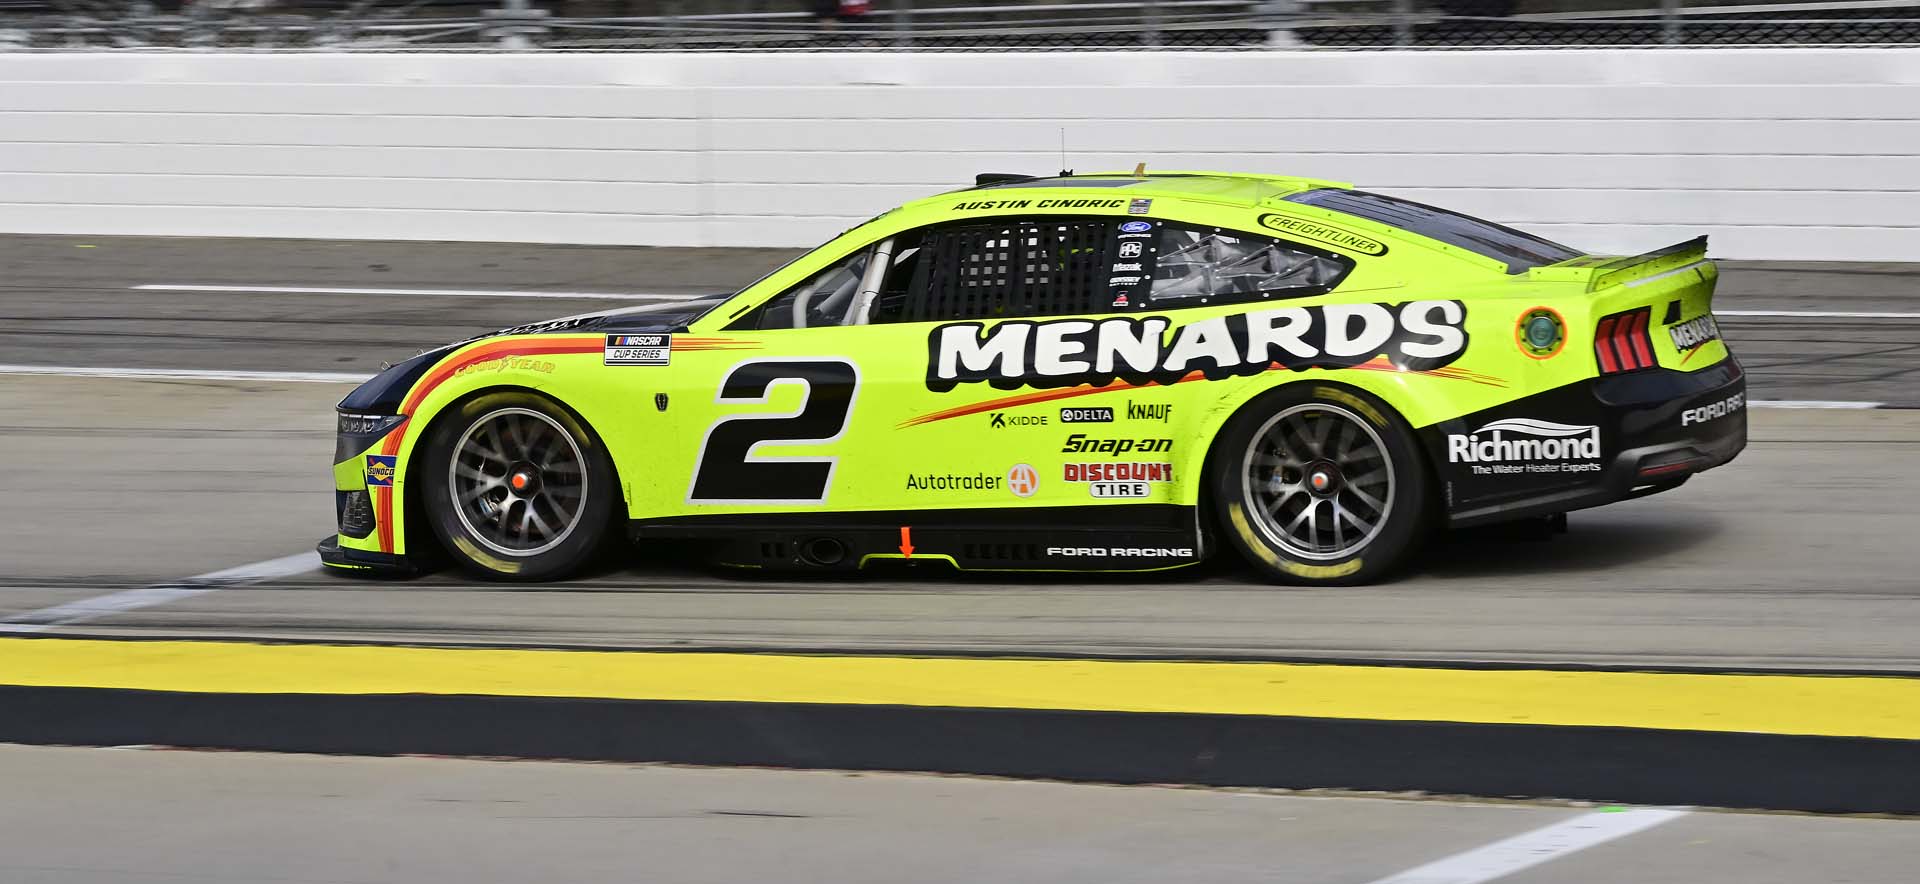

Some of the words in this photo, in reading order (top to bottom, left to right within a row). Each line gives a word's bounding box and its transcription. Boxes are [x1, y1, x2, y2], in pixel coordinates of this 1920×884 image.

[952, 200, 1032, 210] AUSTIN
[1036, 199, 1125, 208] CINDRIC
[1268, 217, 1377, 252] FREIGHTLINER
[626, 336, 662, 346] NASCAR
[932, 299, 1467, 384] MENARDS
[613, 350, 630, 359] CUP
[631, 349, 661, 359] SERIES
[454, 356, 557, 377] GOODYEAR
[1074, 409, 1112, 421] DELTA
[1127, 400, 1172, 423] KNAUF
[1681, 400, 1726, 427] FORD
[1008, 416, 1048, 426] KIDDE
[686, 358, 861, 504] 2
[1062, 434, 1173, 457] Snap-on
[1448, 427, 1600, 462] Richmond
[367, 466, 395, 476] SUNOCO
[1064, 463, 1172, 481] DISCOUNT
[1472, 465, 1492, 475] The
[1492, 464, 1524, 473] Water
[1526, 463, 1559, 473] Heater
[1561, 462, 1601, 473] Experts
[906, 472, 1002, 490] Autotrader
[1096, 484, 1144, 496] TIRE
[1047, 547, 1107, 557] FORD
[1111, 548, 1193, 557] RACING
